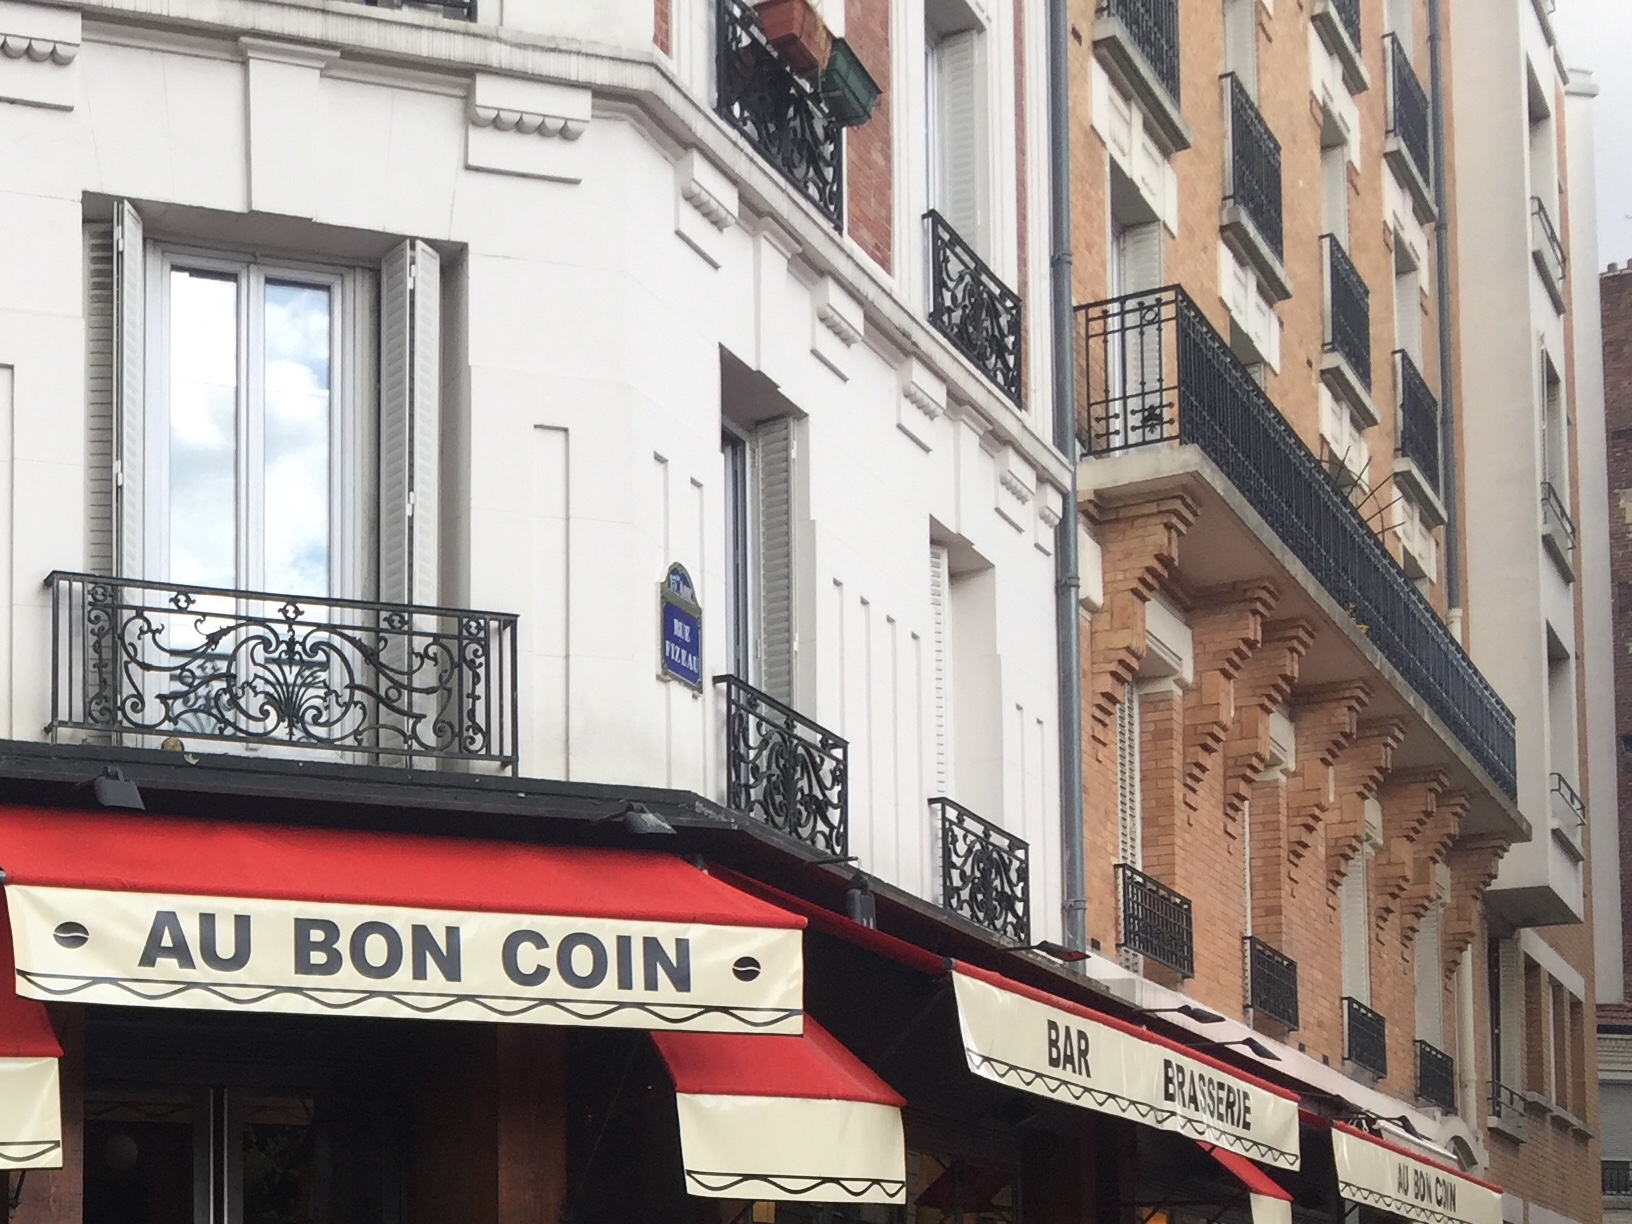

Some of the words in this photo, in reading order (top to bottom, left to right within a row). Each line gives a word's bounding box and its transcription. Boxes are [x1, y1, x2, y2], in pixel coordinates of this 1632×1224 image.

[673, 618, 691, 643] RUE
[137, 911, 253, 972] AU
[293, 917, 463, 983] BON
[501, 930, 693, 993] COIN
[1047, 1018, 1092, 1079] BAR
[1163, 1058, 1251, 1132] BRASSERIE
[1397, 1162, 1410, 1197] AU
[1413, 1168, 1433, 1207] BON
[1434, 1176, 1457, 1214] COIN
